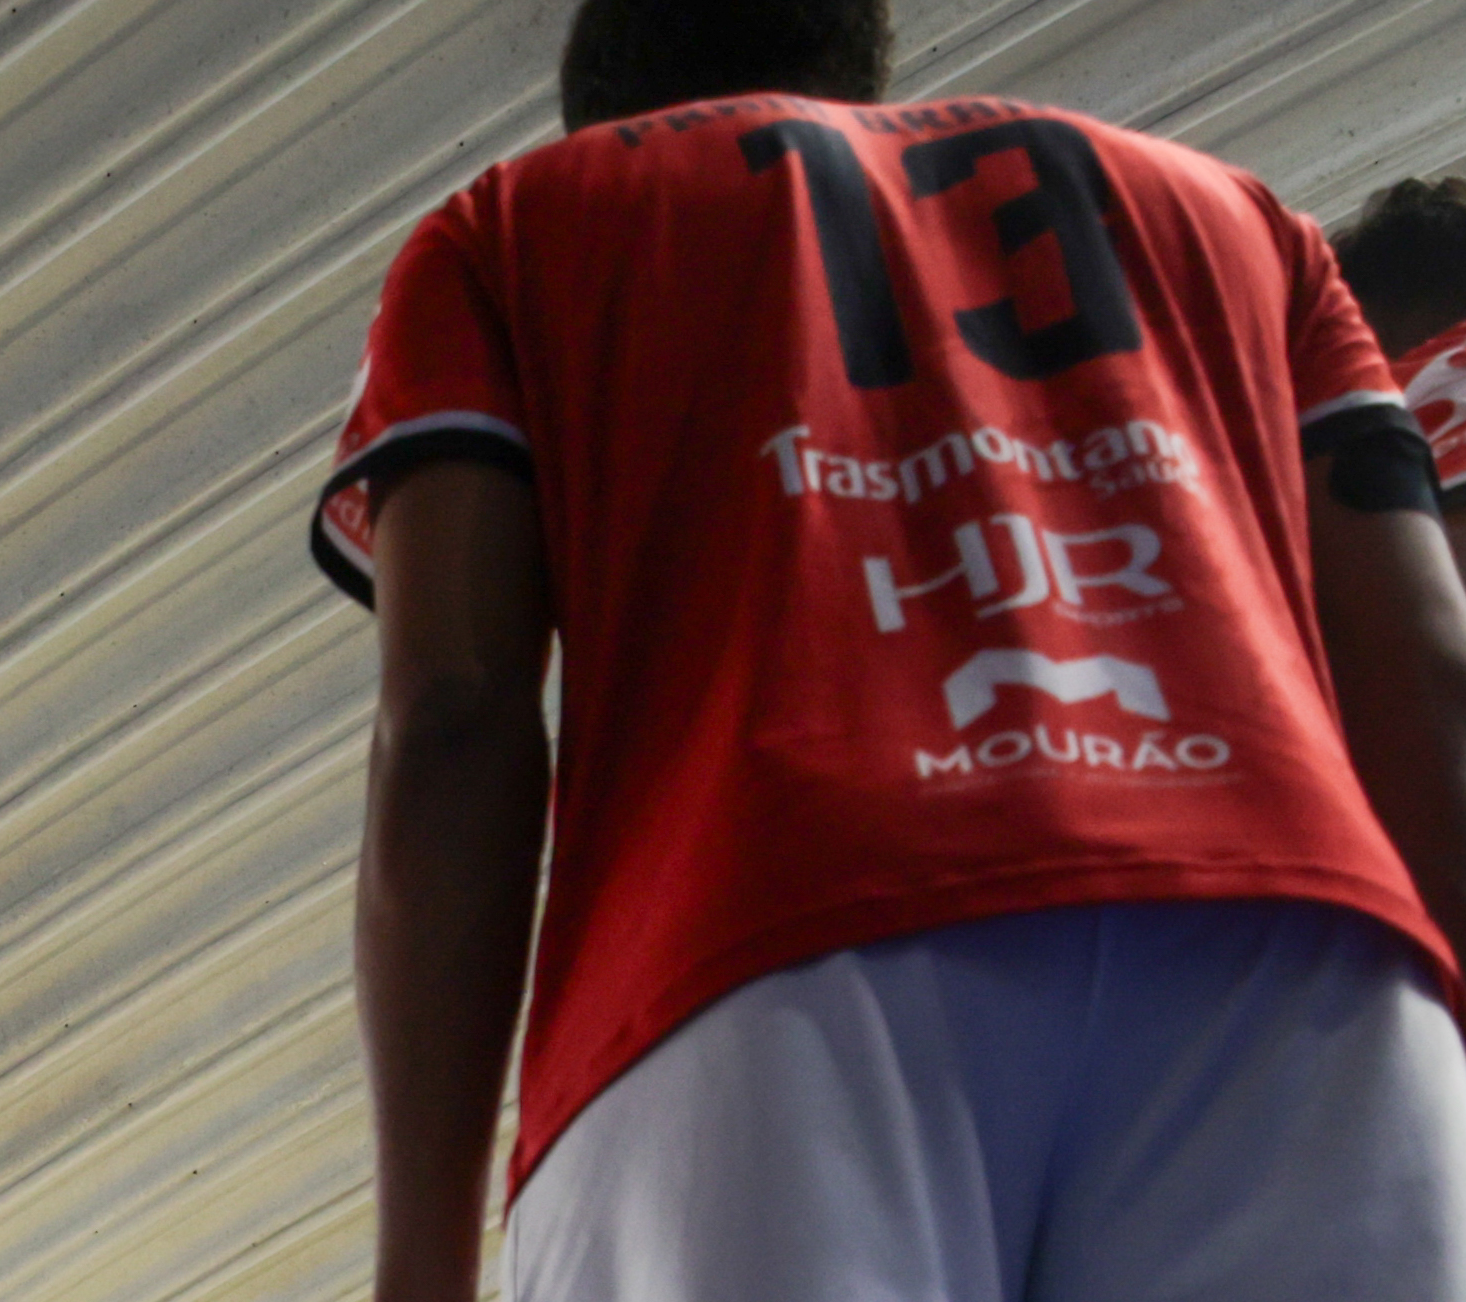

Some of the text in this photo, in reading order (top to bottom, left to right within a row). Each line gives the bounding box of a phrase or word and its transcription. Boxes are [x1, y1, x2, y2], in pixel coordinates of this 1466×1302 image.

[741, 114, 1145, 390] 13
[863, 513, 1174, 633] HJR
[913, 724, 1231, 780] MOURÃO
